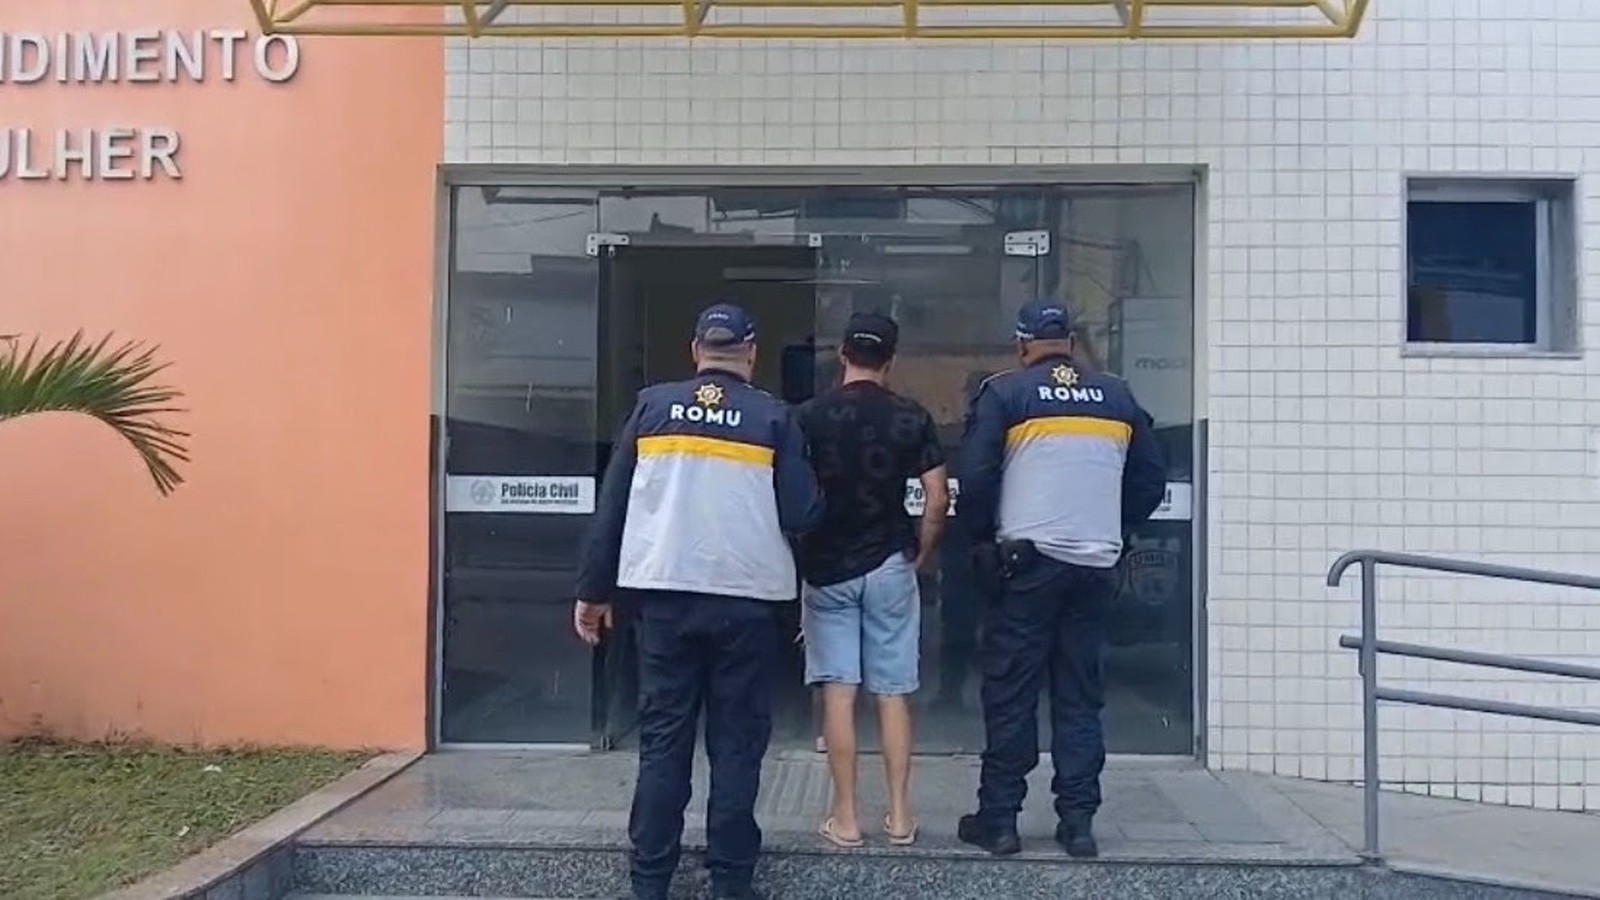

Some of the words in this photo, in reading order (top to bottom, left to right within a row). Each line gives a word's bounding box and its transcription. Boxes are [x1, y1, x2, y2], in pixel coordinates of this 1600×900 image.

[0, 30, 299, 82] DIMENTO
[1038, 386, 1104, 403] ROMU
[670, 404, 741, 427] ROMU
[549, 483, 580, 499] Civil
